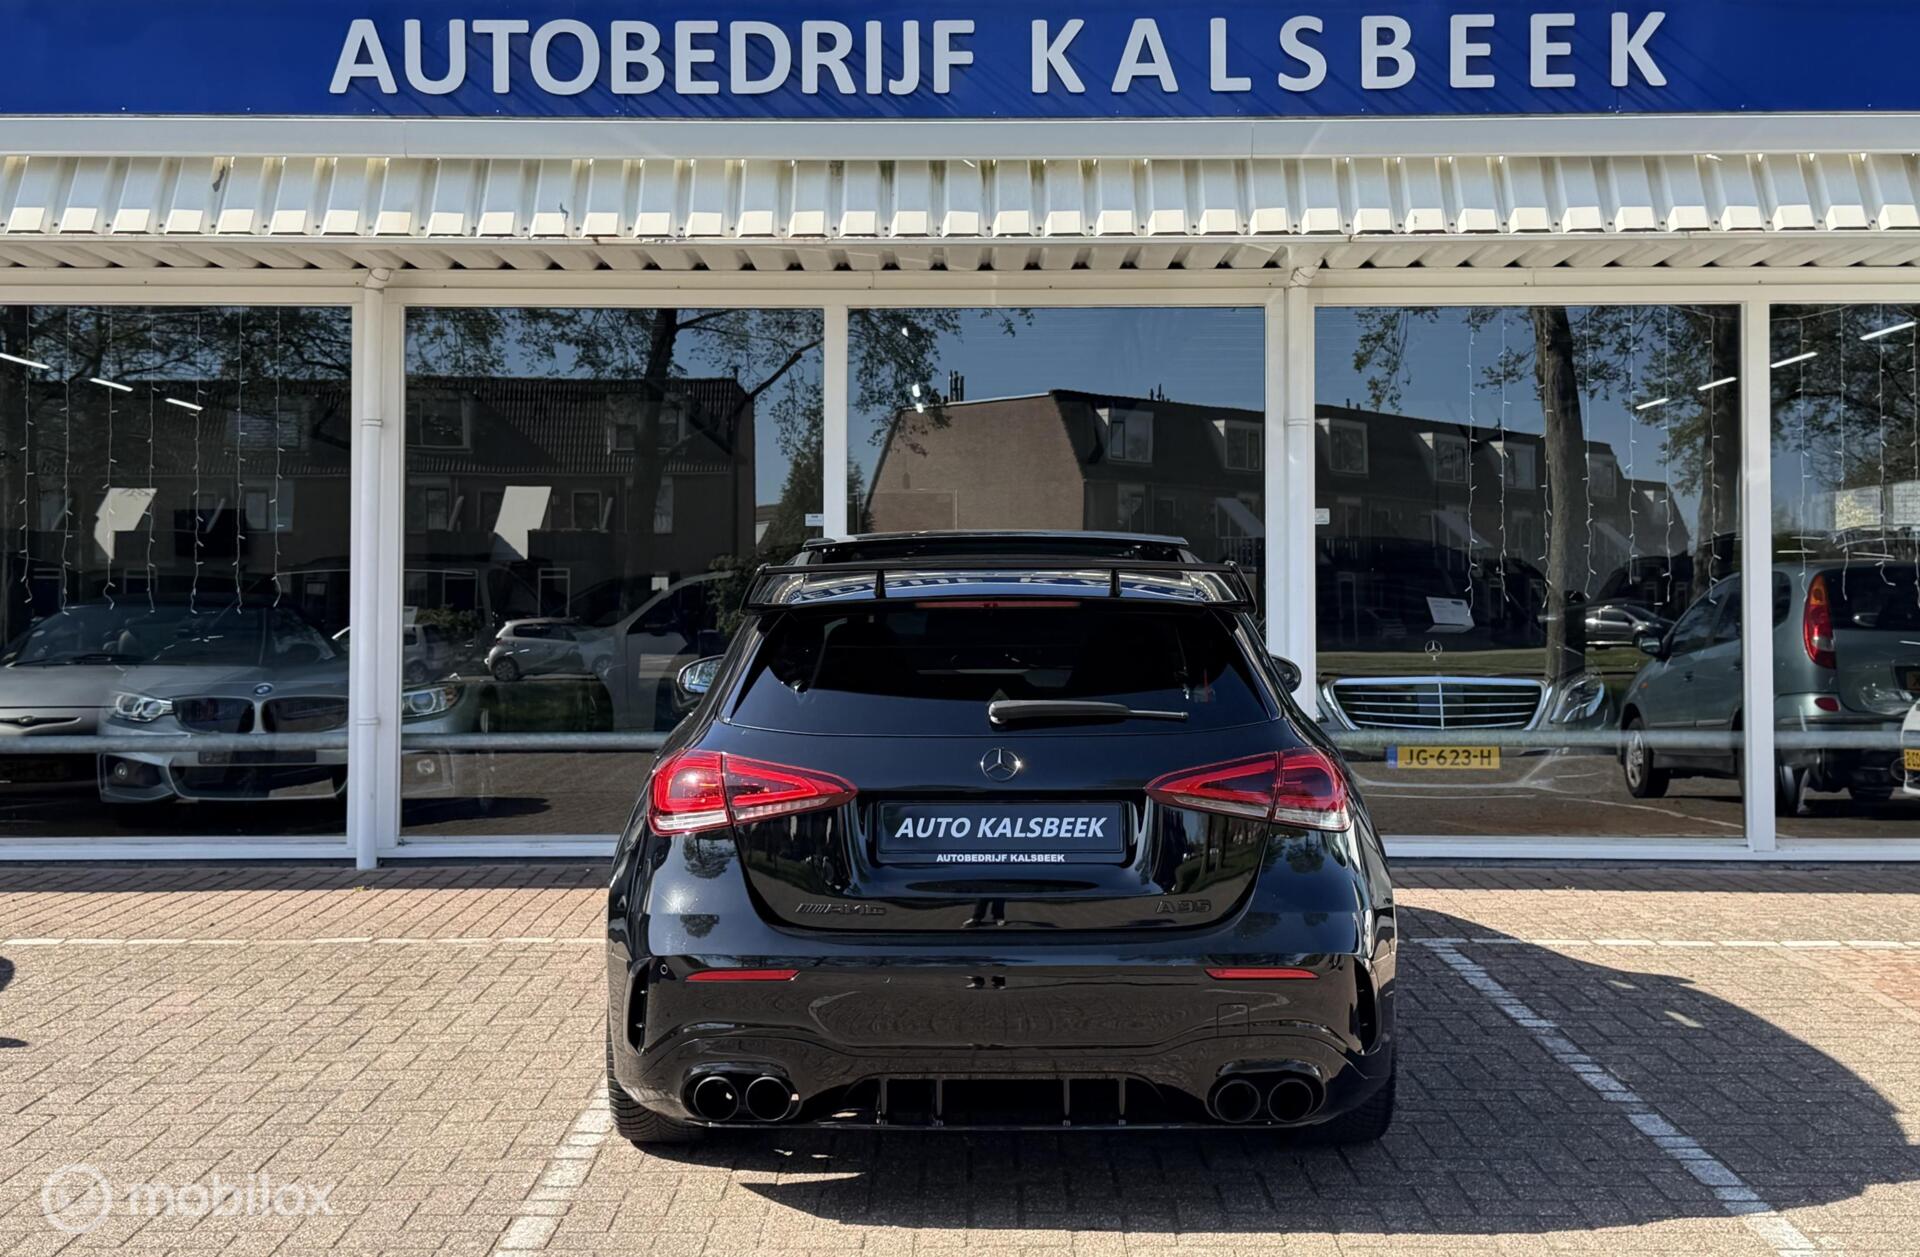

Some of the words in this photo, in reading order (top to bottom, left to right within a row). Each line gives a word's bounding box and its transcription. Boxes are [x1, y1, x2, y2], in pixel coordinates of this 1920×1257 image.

[329, 18, 975, 96] AUTOBEDRIJF
[1031, 12, 1667, 94] KALSBEEK
[1405, 749, 1492, 766] JG-623-H
[895, 817, 971, 838] AUTO
[977, 817, 1107, 838] KALSBEEK
[936, 854, 1008, 863] AUTOBEDRIJF
[1010, 854, 1065, 863] KALSBEEK
